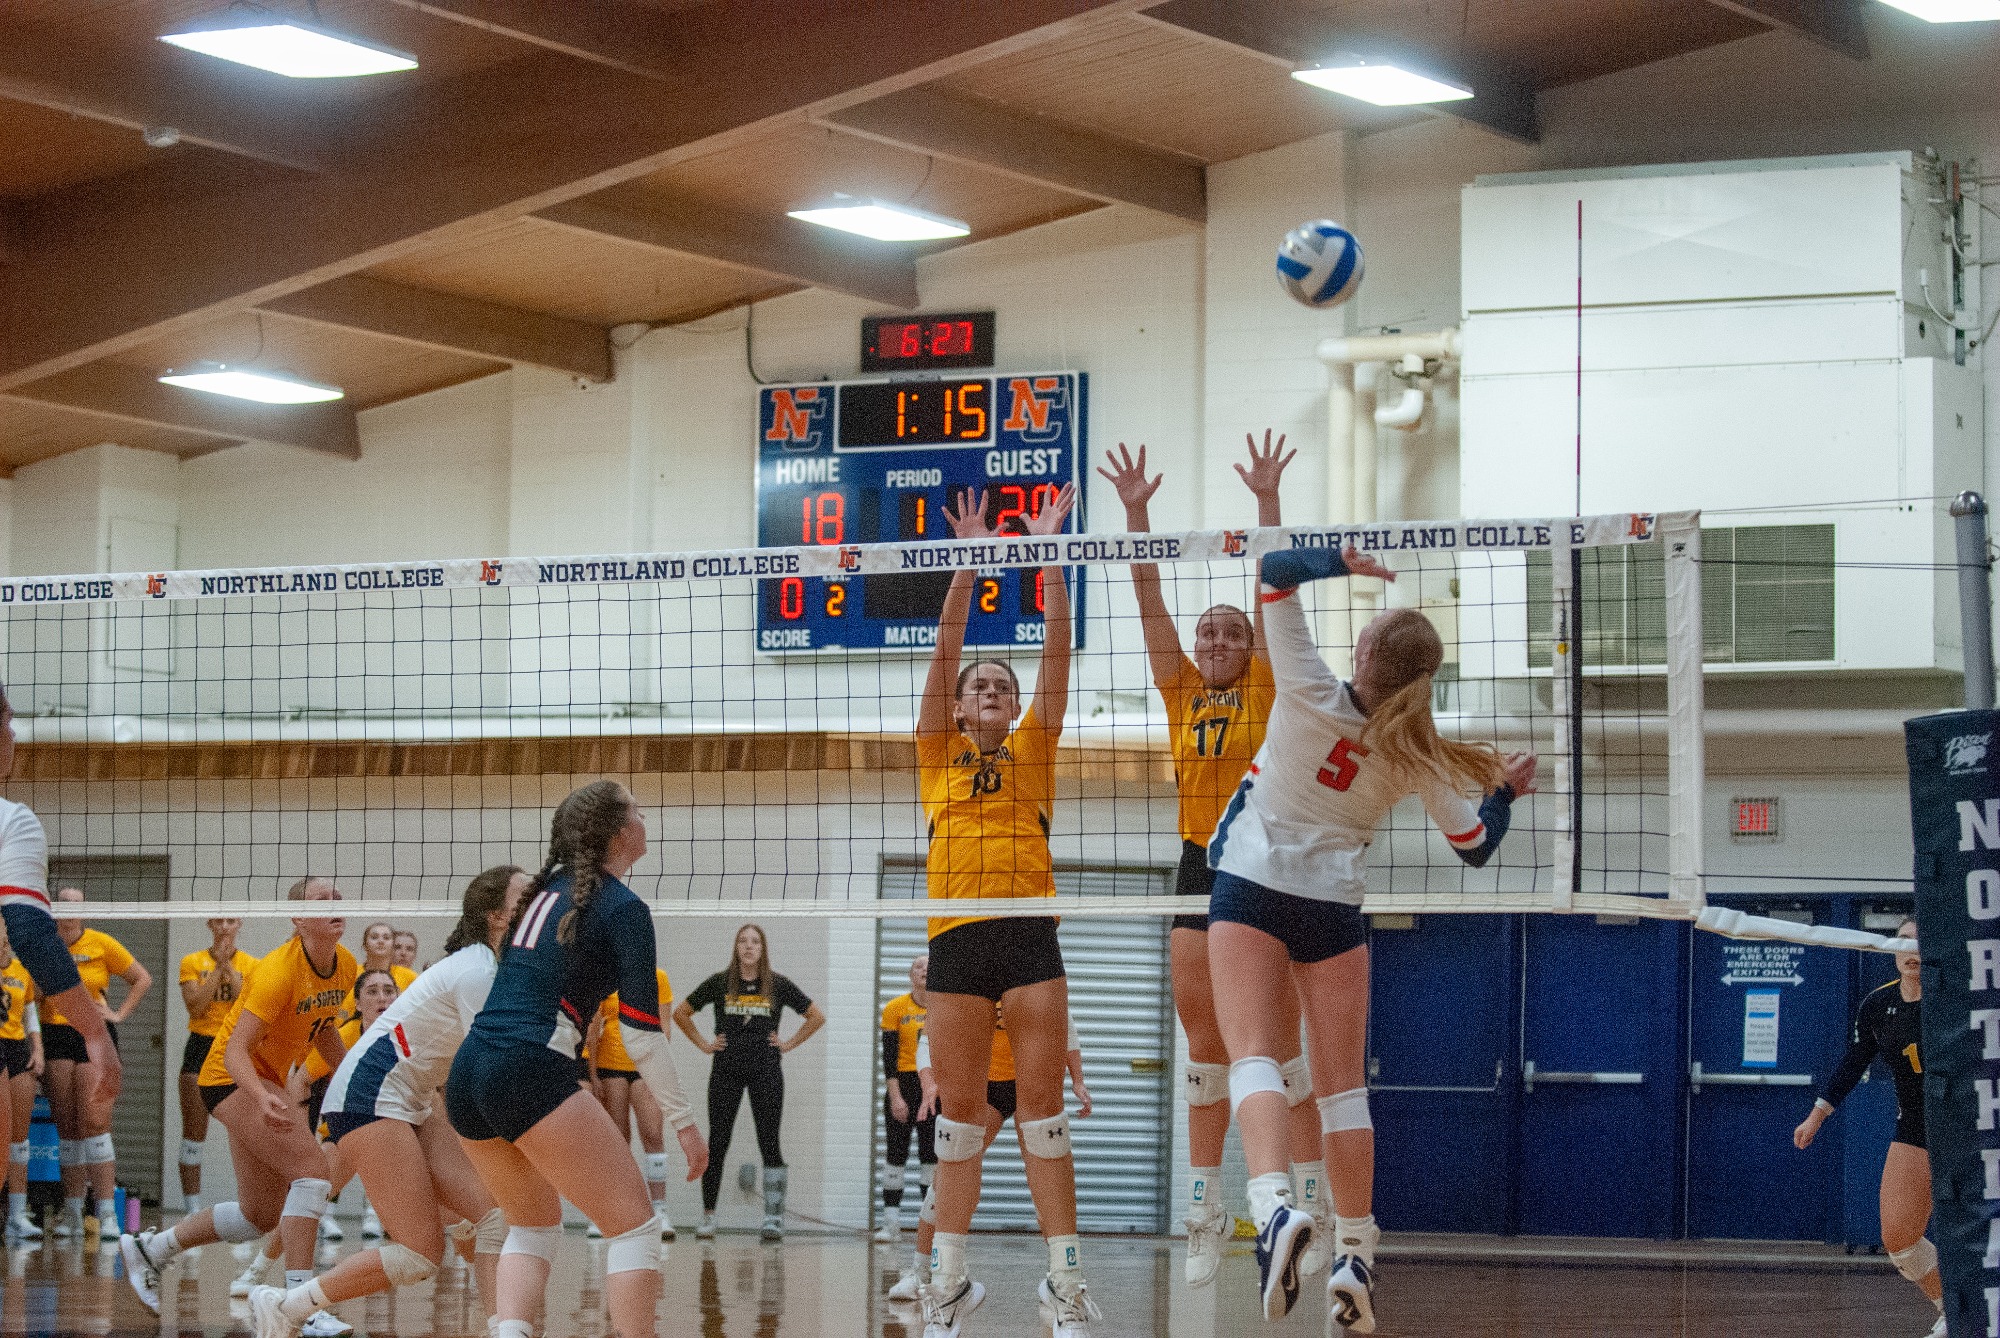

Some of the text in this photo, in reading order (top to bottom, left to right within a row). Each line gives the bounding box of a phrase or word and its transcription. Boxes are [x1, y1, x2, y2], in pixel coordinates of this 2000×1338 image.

[901, 321, 974, 357] 6:27
[897, 384, 986, 438] 1:15
[775, 457, 840, 485] HOME
[986, 448, 1062, 478] GUEST
[886, 468, 942, 488] PERIOD
[802, 492, 844, 545] 18
[916, 497, 925, 535] 1
[1289, 523, 1586, 551] NORTHLAND COLLEE
[901, 538, 1182, 569] NORTHLAND COLLEGE
[200, 567, 445, 595] NORTHLAND COLLEGE
[538, 554, 800, 583] NORTHLAND COLLEGE
[21, 580, 114, 601] COLLEGE
[779, 577, 803, 620] 0
[825, 583, 846, 617] 2
[980, 579, 1000, 613] 2
[761, 630, 811, 647] SCORE
[885, 626, 938, 645] MATCH
[1015, 622, 1045, 642] SCO
[1192, 716, 1229, 757] 17
[1316, 736, 1372, 793] 5
[511, 890, 560, 950] 11
[1723, 946, 1805, 954] THESE DOORS
[1726, 960, 1800, 968] EMERGENCY
[1739, 953, 1762, 961] ARE
[1732, 969, 1794, 977] EXIT ONLY
